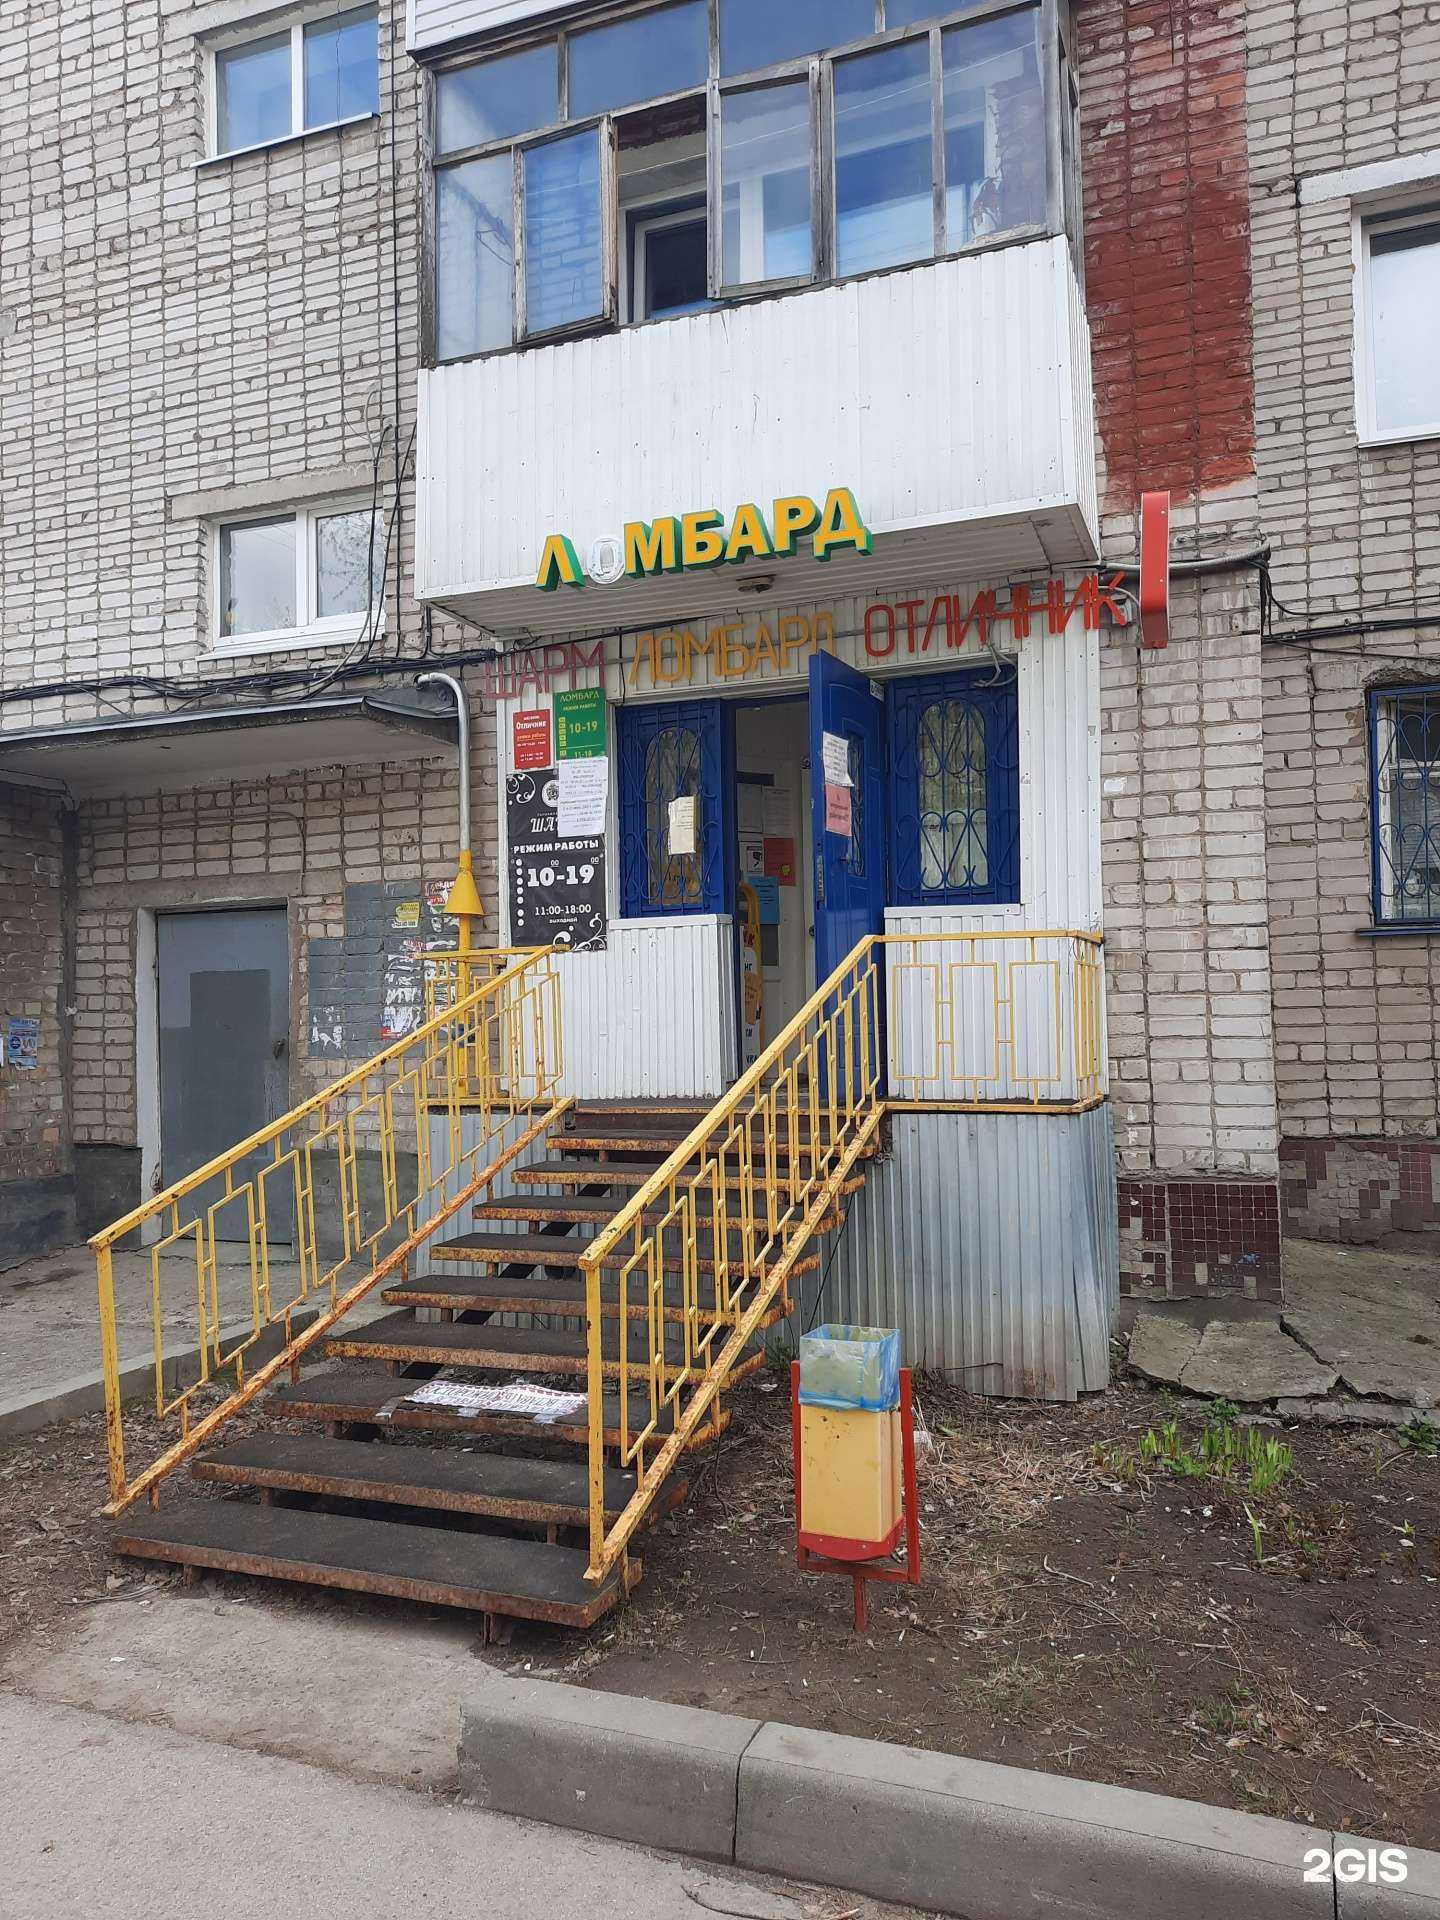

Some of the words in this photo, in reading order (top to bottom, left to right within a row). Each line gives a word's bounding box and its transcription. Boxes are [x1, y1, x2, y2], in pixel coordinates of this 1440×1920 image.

[535, 486, 872, 593] ЛОМБАРД
[864, 571, 1127, 657] ОТЛИЧНИК
[629, 611, 834, 684] ЛОМБАРД
[483, 641, 606, 699] ШАРМ
[569, 720, 598, 734] 10-19
[530, 816, 558, 833] ША
[513, 843, 553, 854] РЕЖИМ
[554, 840, 599, 851] РАБОТЫ
[527, 864, 595, 887] 10-19
[535, 904, 592, 916] 11:00-18:00
